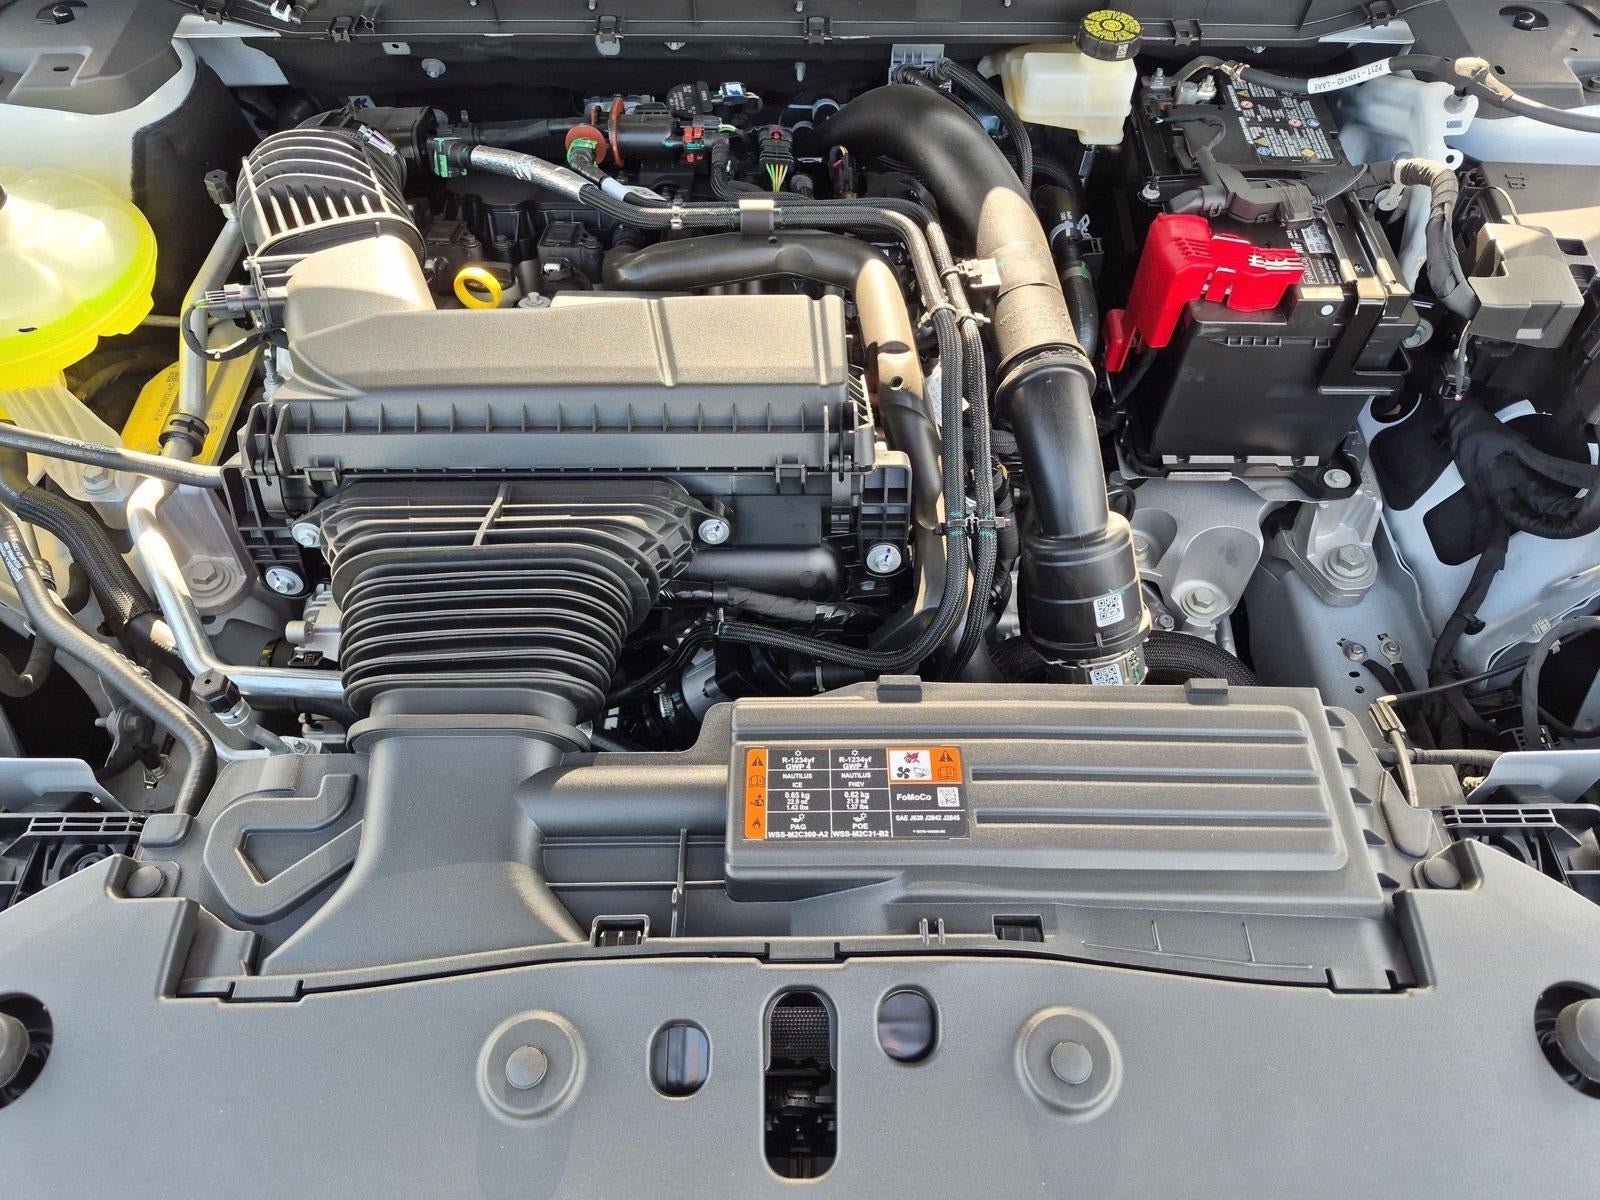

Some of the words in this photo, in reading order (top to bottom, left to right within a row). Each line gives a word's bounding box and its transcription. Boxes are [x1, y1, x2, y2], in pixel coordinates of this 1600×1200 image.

[781, 756, 815, 765] R-1234yf
[838, 756, 872, 765] R-1234yf
[800, 792, 810, 800] kg
[860, 791, 870, 800] kg
[896, 793, 932, 801] FoMoCo
[768, 830, 829, 838] WSS-M2C300-A2
[832, 830, 889, 838] WSS-M2C31-B2
